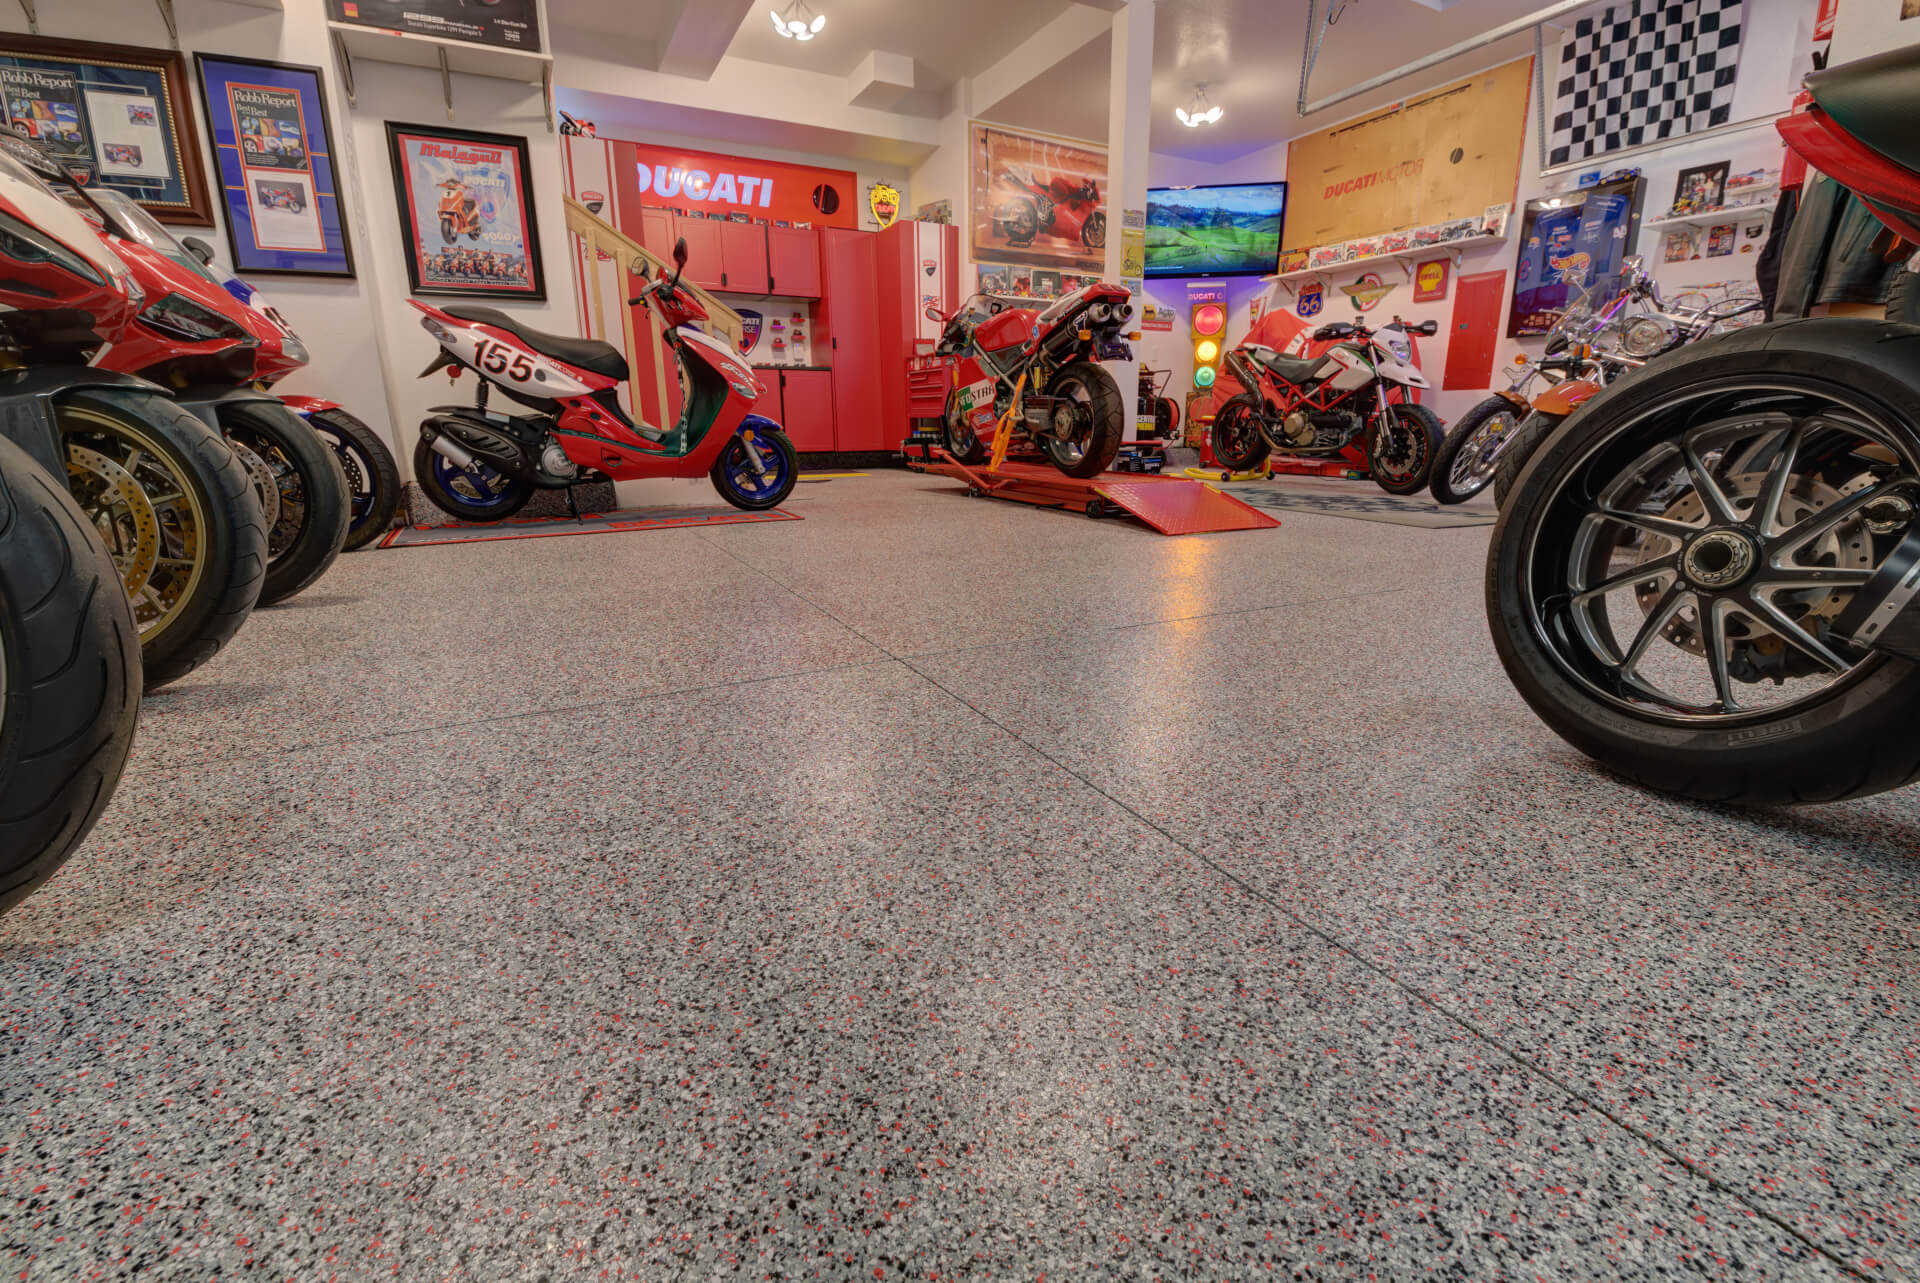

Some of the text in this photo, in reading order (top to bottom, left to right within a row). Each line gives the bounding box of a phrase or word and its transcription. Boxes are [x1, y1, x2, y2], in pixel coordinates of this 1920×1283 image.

[1, 70, 74, 89] Robb Report
[234, 90, 296, 108] Robb Report
[637, 162, 773, 208] DUCATI
[1188, 292, 1216, 300] DUCATI
[1300, 295, 1320, 313] 66
[474, 339, 535, 383] 155
